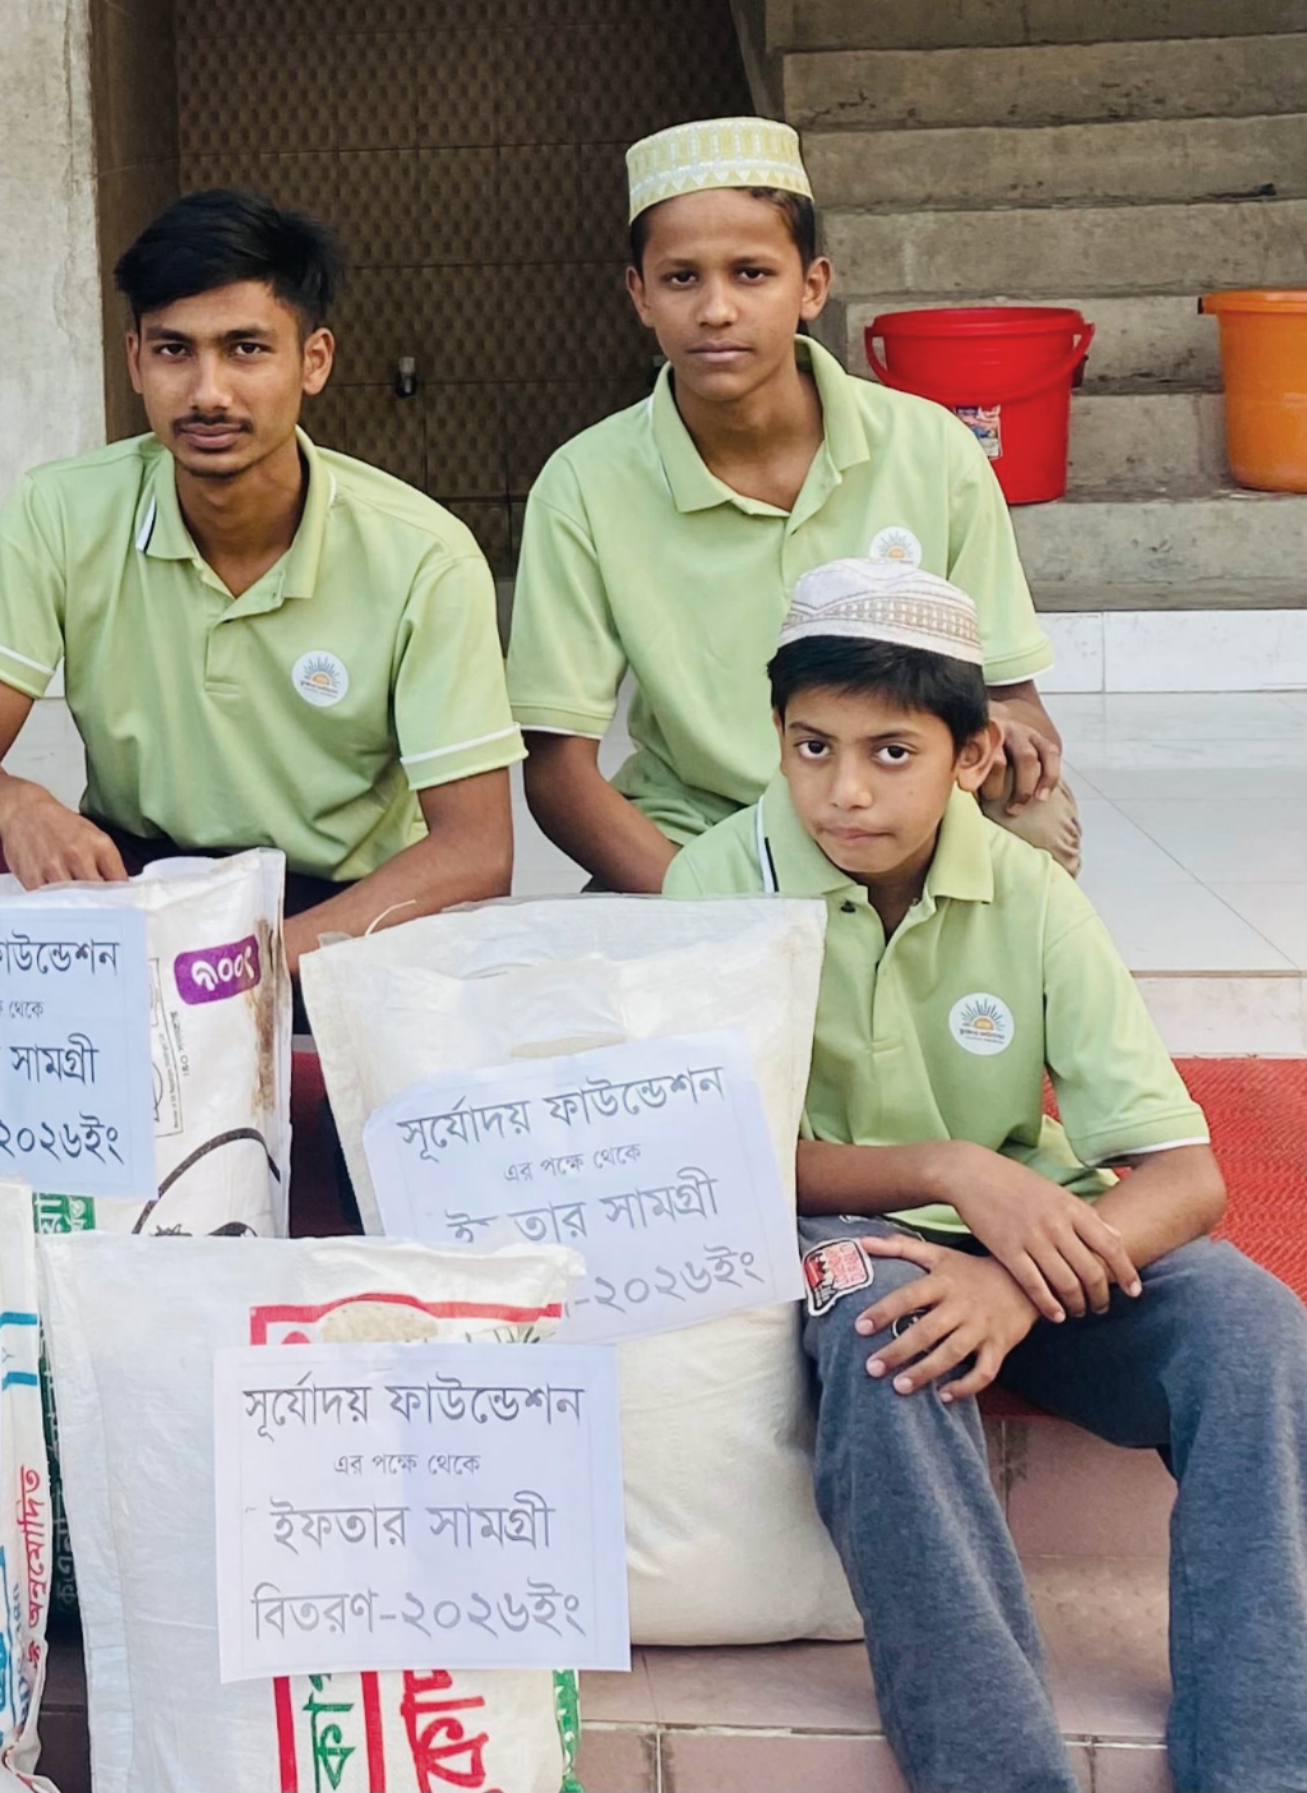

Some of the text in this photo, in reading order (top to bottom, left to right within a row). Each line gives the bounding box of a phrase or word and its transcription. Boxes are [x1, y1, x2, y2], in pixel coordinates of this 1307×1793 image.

[8, 1001, 44, 1019] থেকে
[9, 1033, 99, 1085] সামগ্রী
[396, 1067, 723, 1162] সূর্যোদয় ফাউন্ডেশন
[505, 1144, 641, 1181] এর পক্ষে থেকে
[446, 1166, 718, 1243] ইতার সামগ্রী
[242, 1371, 585, 1442] সূর্যোদয় ফাউন্ডেশন
[334, 1454, 481, 1475] এর পক্ষে থেকে
[16, 1464, 47, 1629] অনুমোদিত
[270, 1490, 555, 1554] ইফতার সামগ্রী
[251, 1579, 584, 1639] বিতরণ-২০২৬ইং
